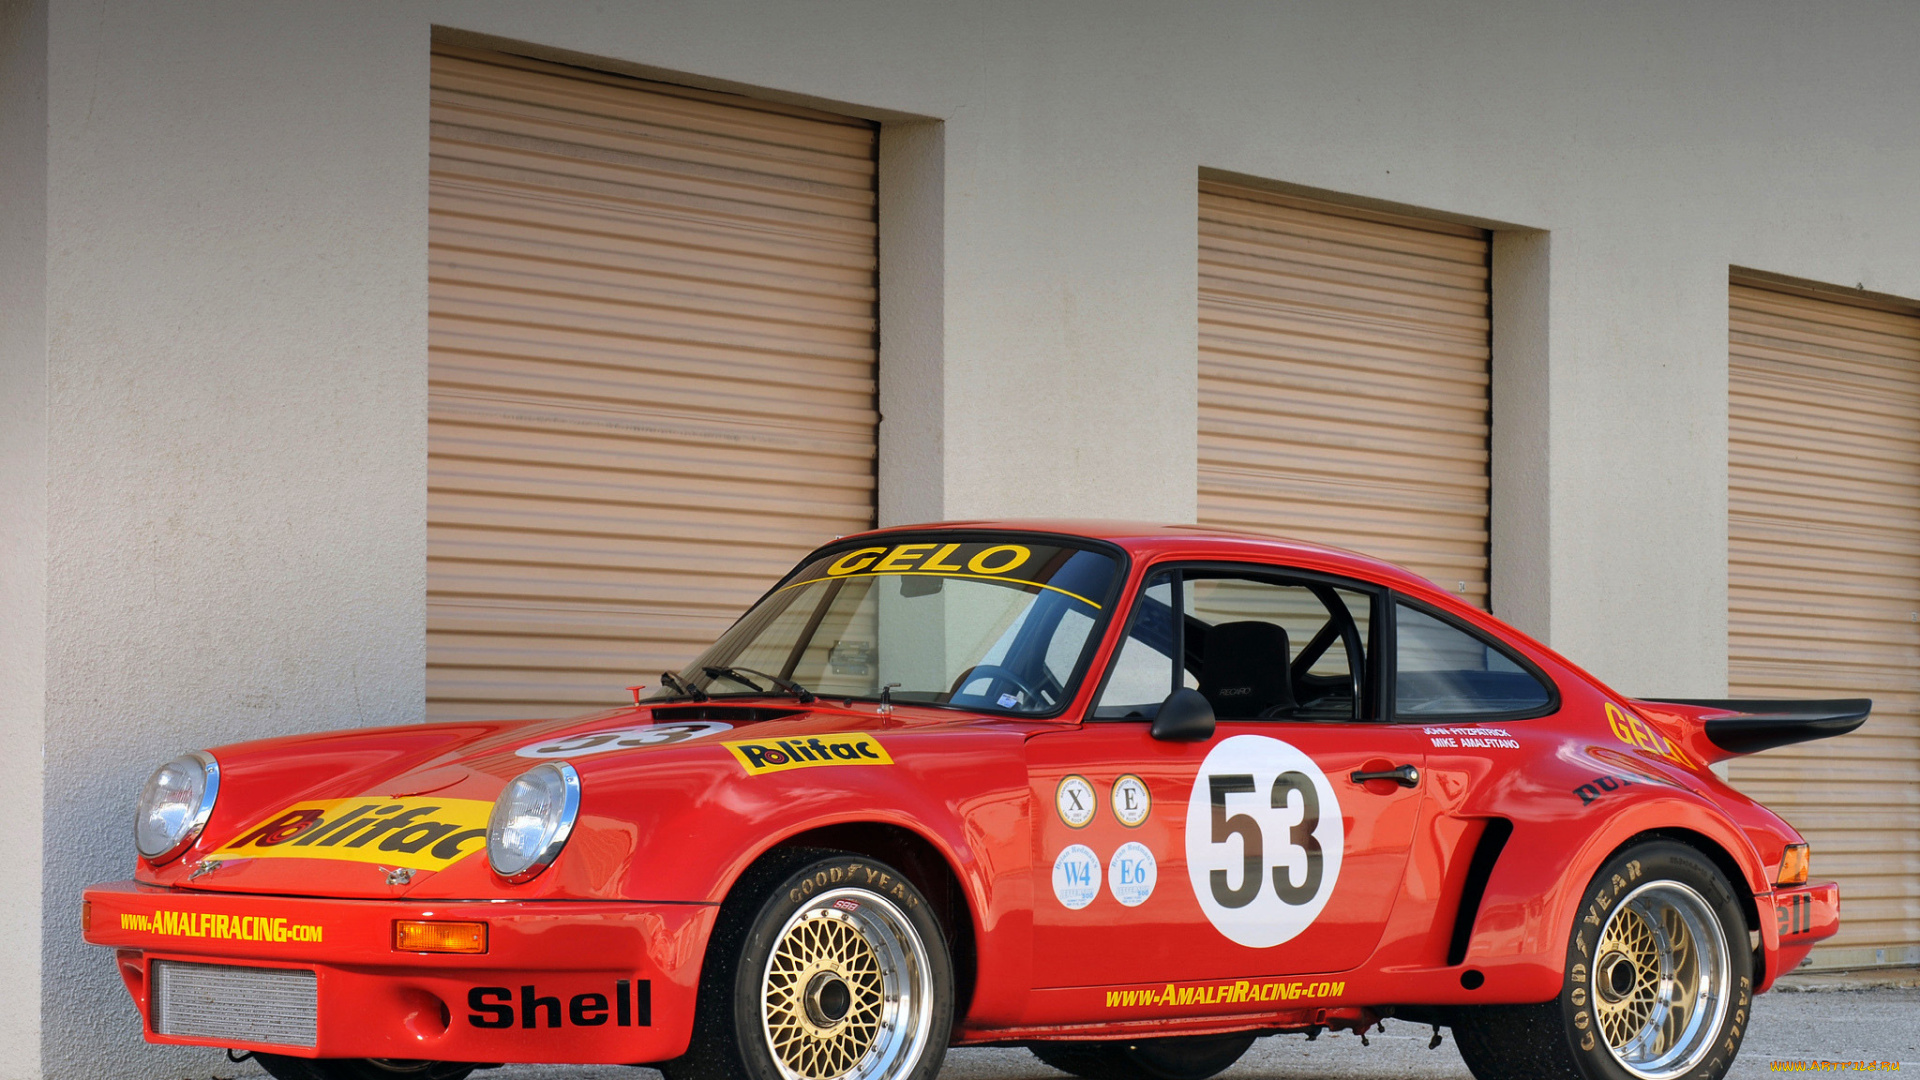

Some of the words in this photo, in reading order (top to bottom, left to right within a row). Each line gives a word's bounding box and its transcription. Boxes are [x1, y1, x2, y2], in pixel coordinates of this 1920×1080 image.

[827, 543, 1031, 575] GELO
[536, 725, 711, 753] 53
[1423, 727, 1450, 735] JOHN
[1450, 728, 1511, 737] FITZPATRICK
[1430, 738, 1458, 747] MIKE
[1460, 738, 1519, 749] AMALFITANO
[1605, 702, 1698, 770] GELO
[738, 739, 879, 768] Polifac
[1068, 789, 1084, 810] X
[1123, 788, 1138, 810] E
[226, 804, 486, 859] Polifac
[1208, 770, 1323, 909] 53
[1064, 861, 1090, 886] W4
[1120, 858, 1146, 884] E6
[468, 980, 651, 1029] Shell
[1725, 976, 1749, 1056] EAGLE
